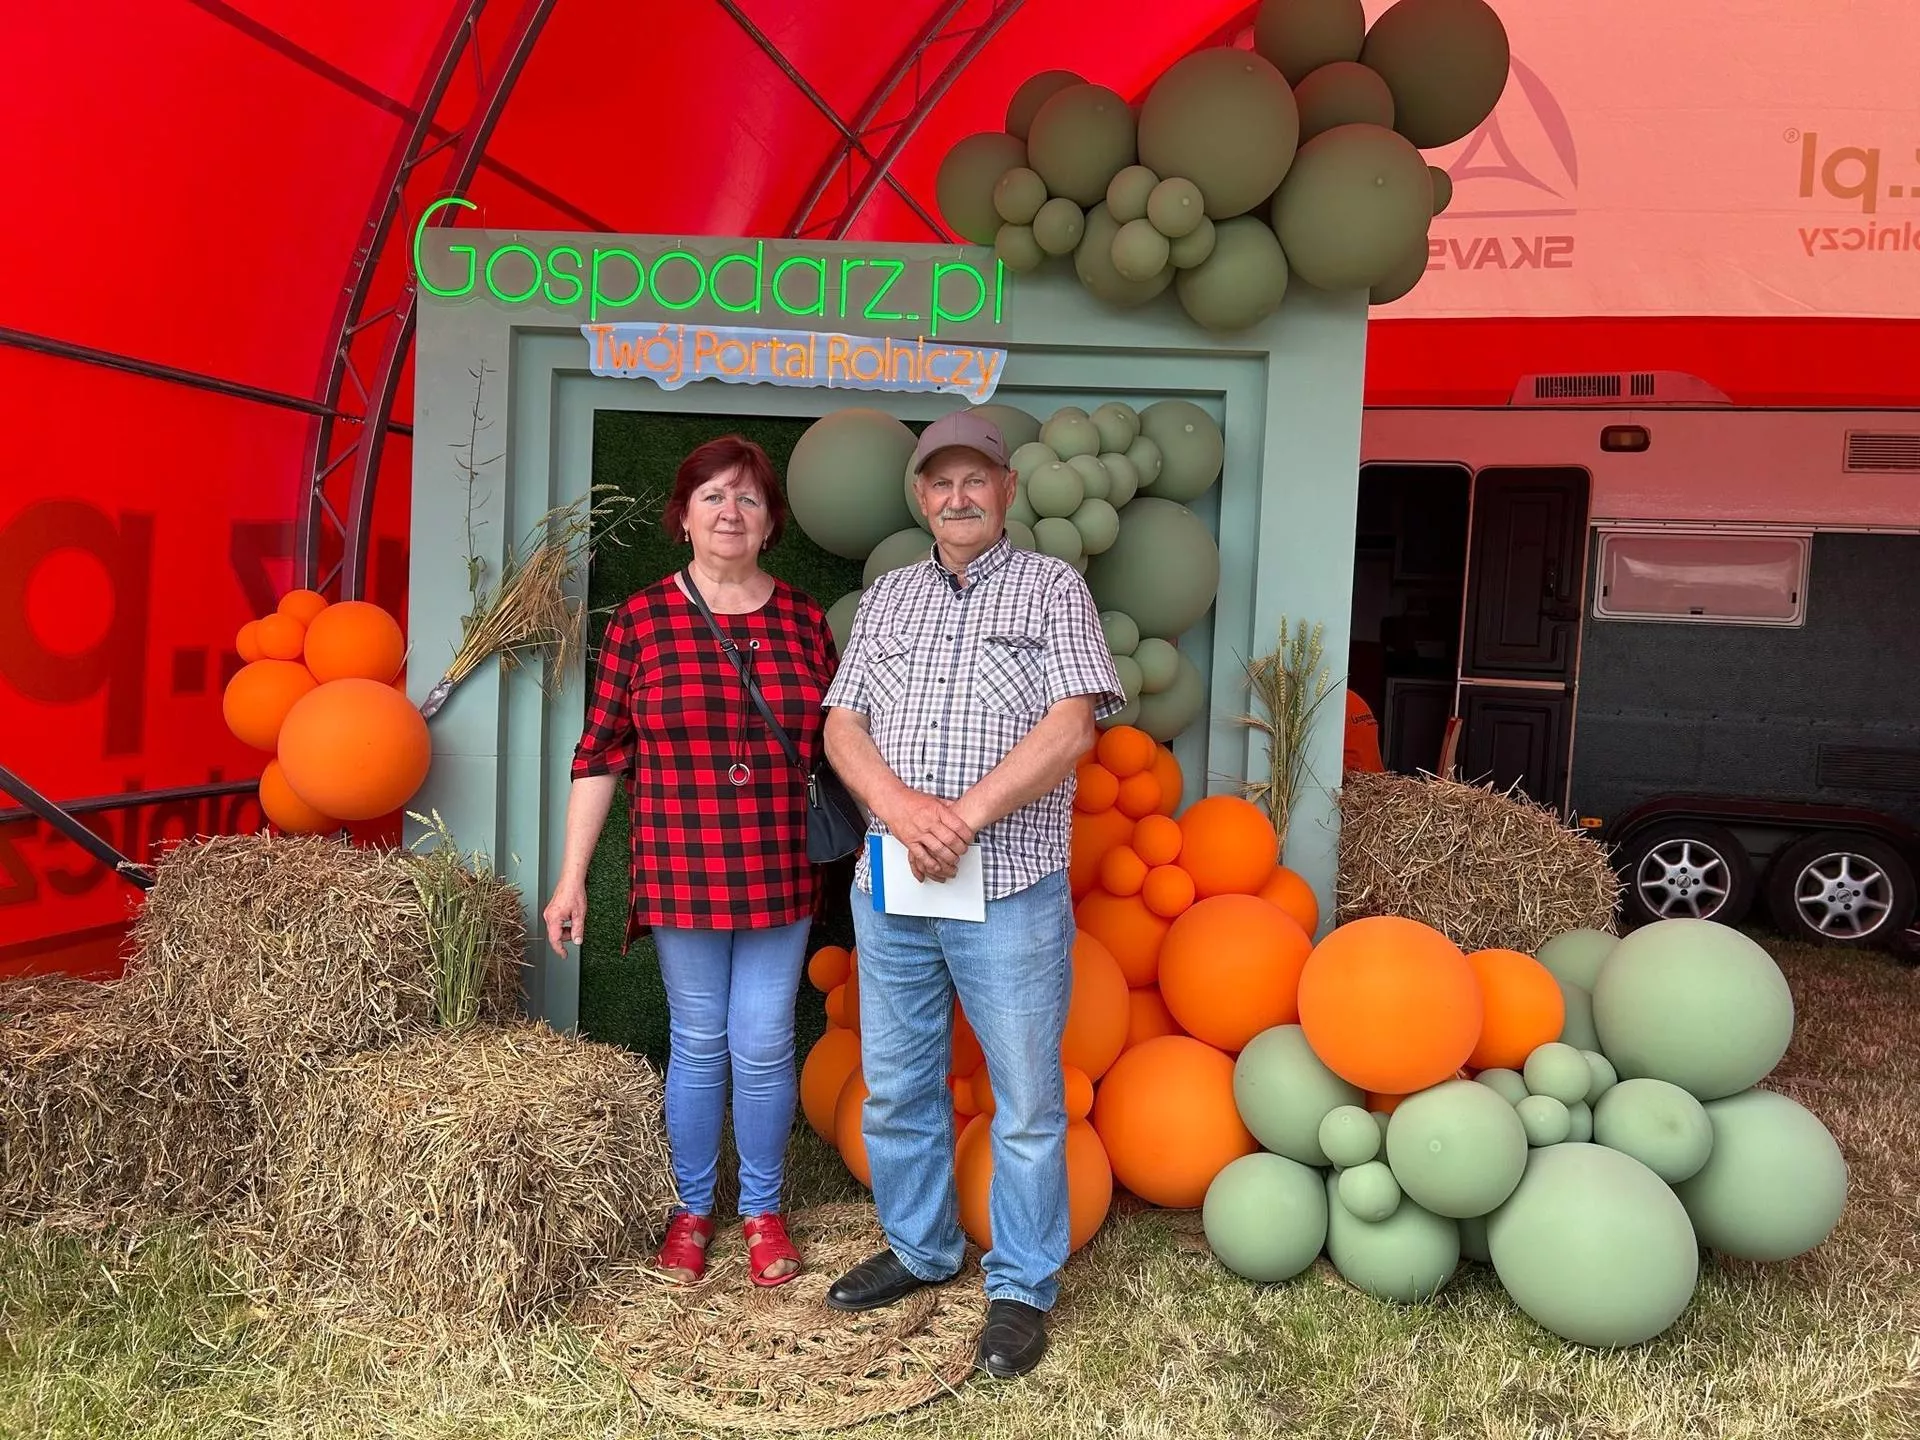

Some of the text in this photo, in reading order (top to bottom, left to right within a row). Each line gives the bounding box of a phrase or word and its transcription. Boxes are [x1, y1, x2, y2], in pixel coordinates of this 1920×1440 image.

[412, 197, 1005, 337] Gospodarz.pl
[588, 323, 1000, 396] Twój Portal Rolniczy
